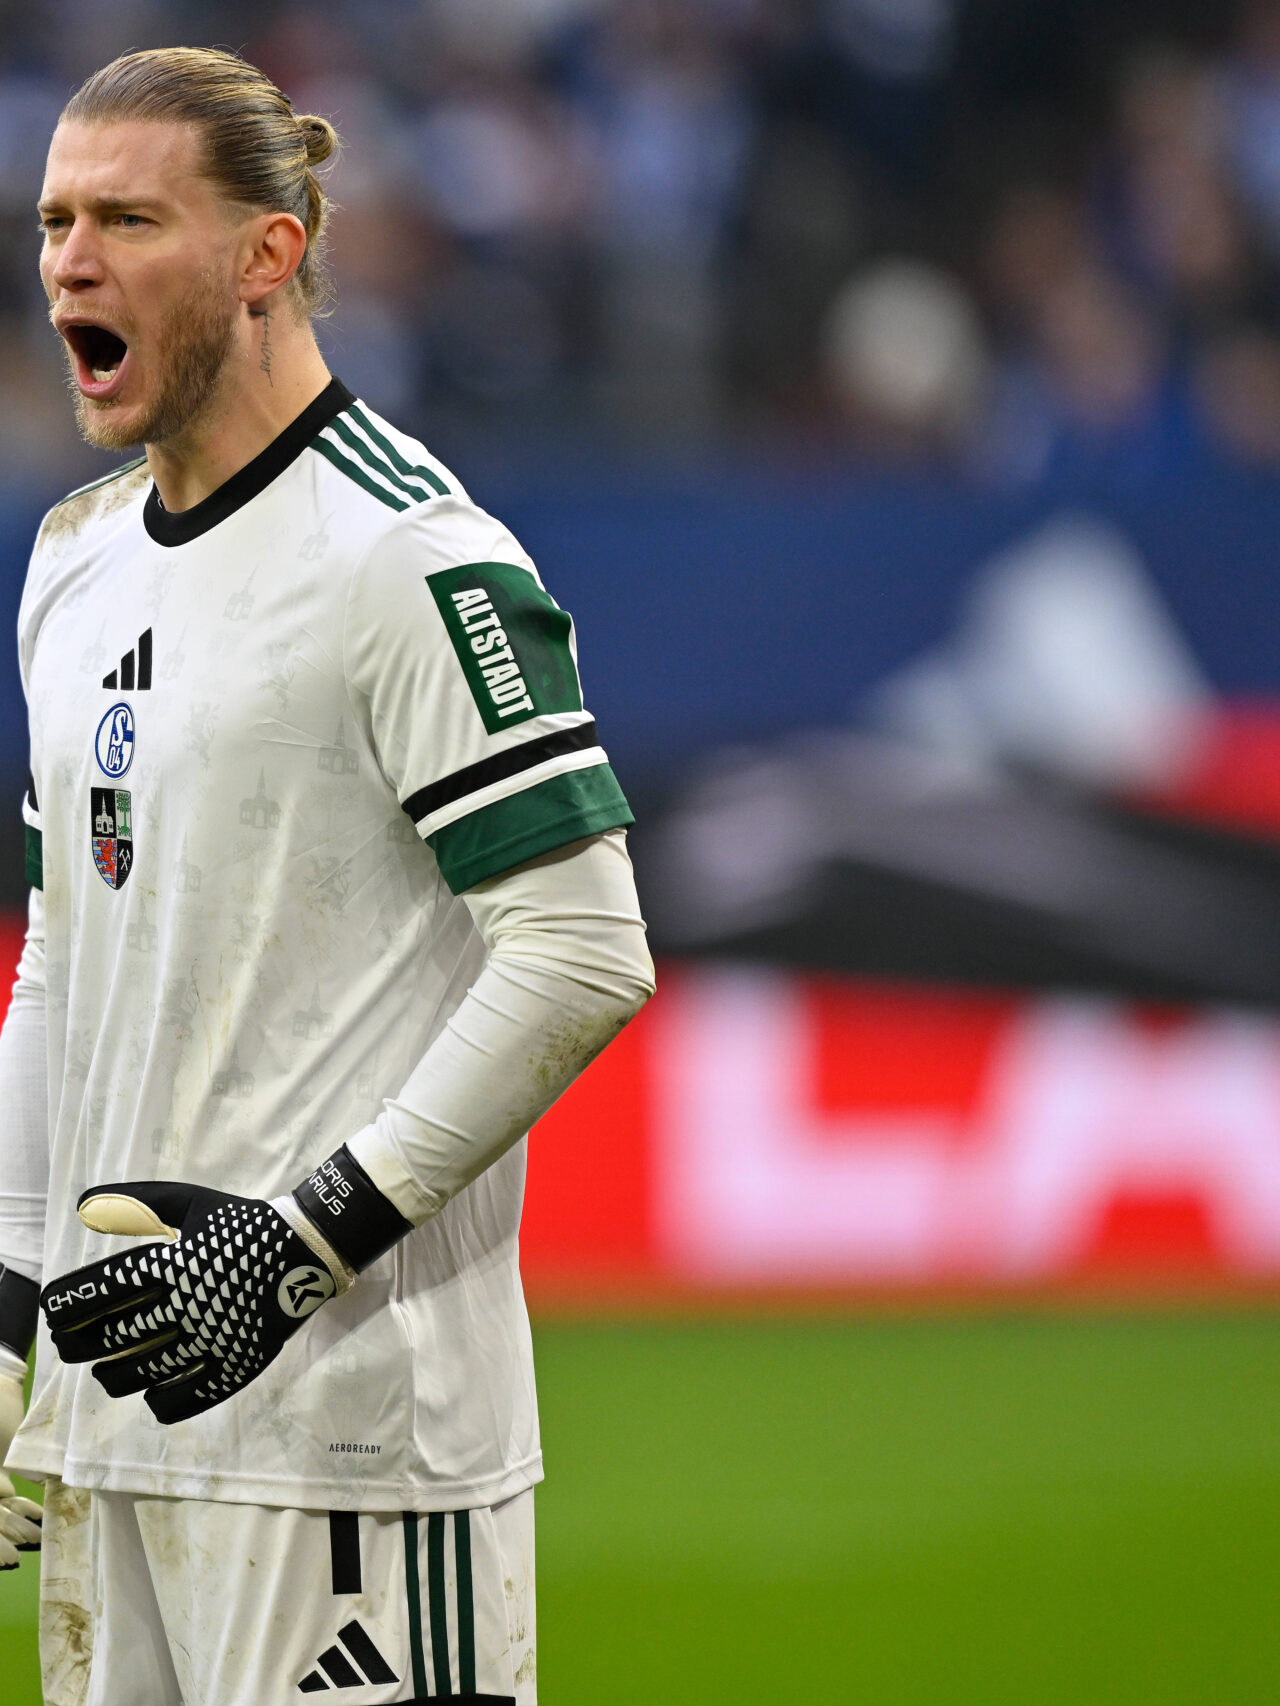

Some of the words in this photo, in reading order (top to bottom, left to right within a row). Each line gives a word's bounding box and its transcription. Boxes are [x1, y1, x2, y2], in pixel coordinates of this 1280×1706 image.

[451, 588, 535, 719] ALTSTADT
[308, 1171, 346, 1216] ARIUS
[319, 1159, 354, 1198] ORIS
[328, 1443, 382, 1455] AEROREADY
